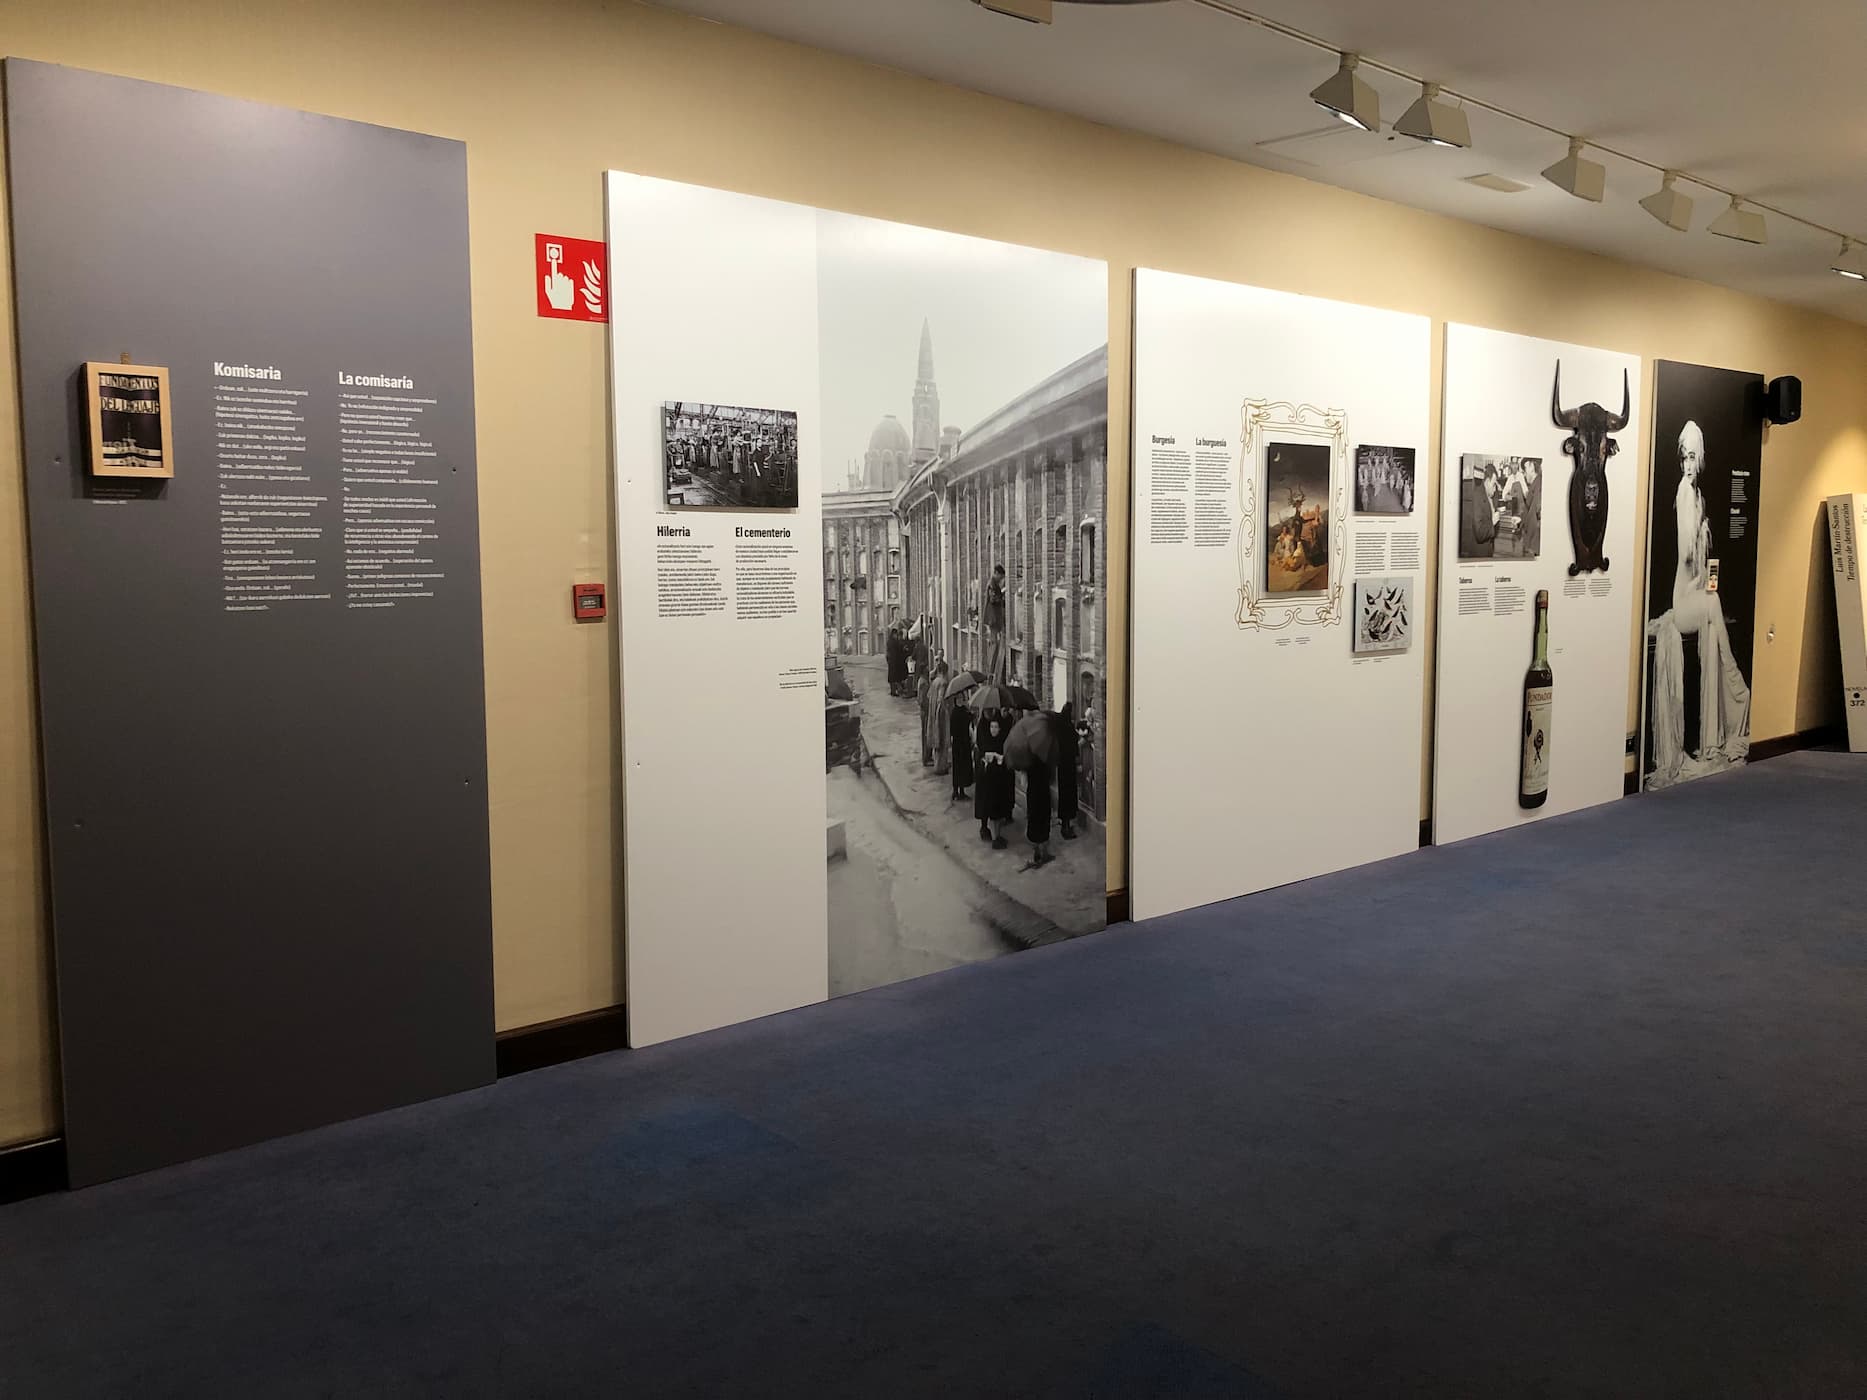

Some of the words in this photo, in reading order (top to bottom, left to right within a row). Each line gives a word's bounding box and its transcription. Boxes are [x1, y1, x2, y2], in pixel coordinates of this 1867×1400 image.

[213, 361, 282, 381] Komisaria
[338, 370, 354, 385] La
[101, 397, 119, 411] DEL
[1195, 437, 1202, 446] La
[656, 525, 691, 537] Hilerria
[735, 526, 743, 538] El
[744, 527, 791, 538] cementerio
[1845, 543, 1852, 553] de
[1835, 557, 1844, 573] Luis
[1847, 555, 1856, 582] Tiempo
[1850, 699, 1866, 707] 372
